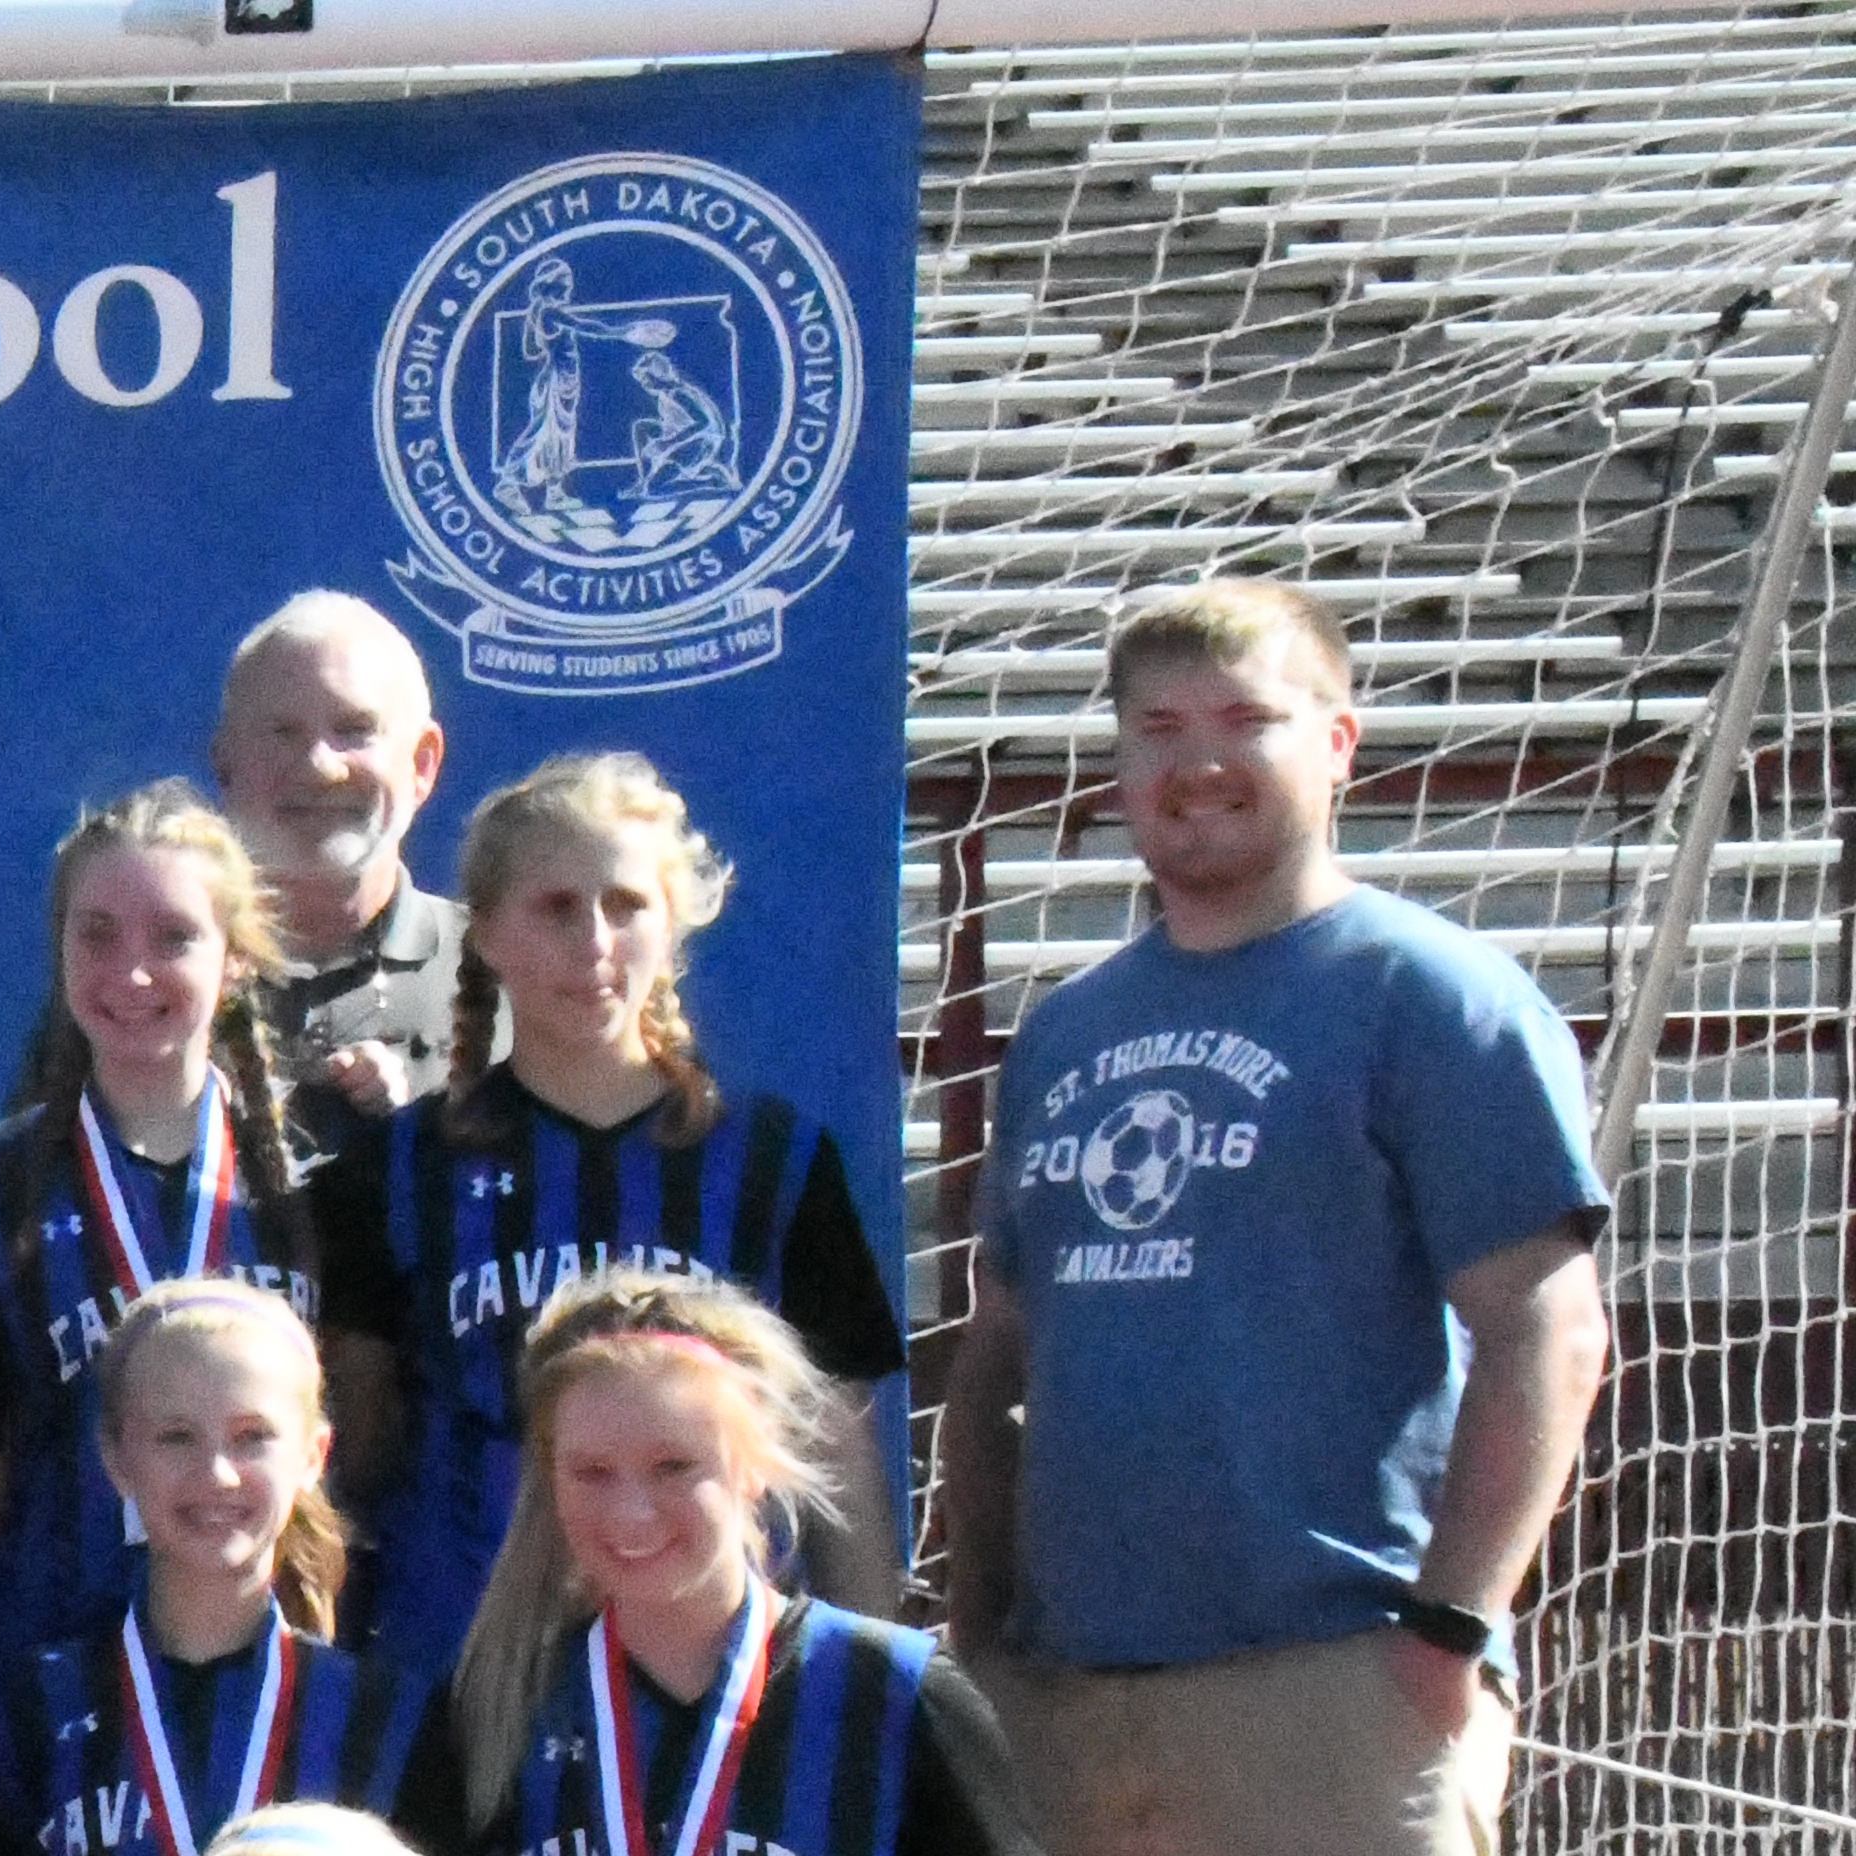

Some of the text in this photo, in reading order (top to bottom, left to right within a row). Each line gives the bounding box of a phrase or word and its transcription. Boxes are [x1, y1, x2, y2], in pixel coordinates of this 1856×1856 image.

[454, 182, 775, 291] SOUTH DAKOTA
[402, 290, 834, 606] HIGH SCHOOL ACTIVITIES ASSOCIATION
